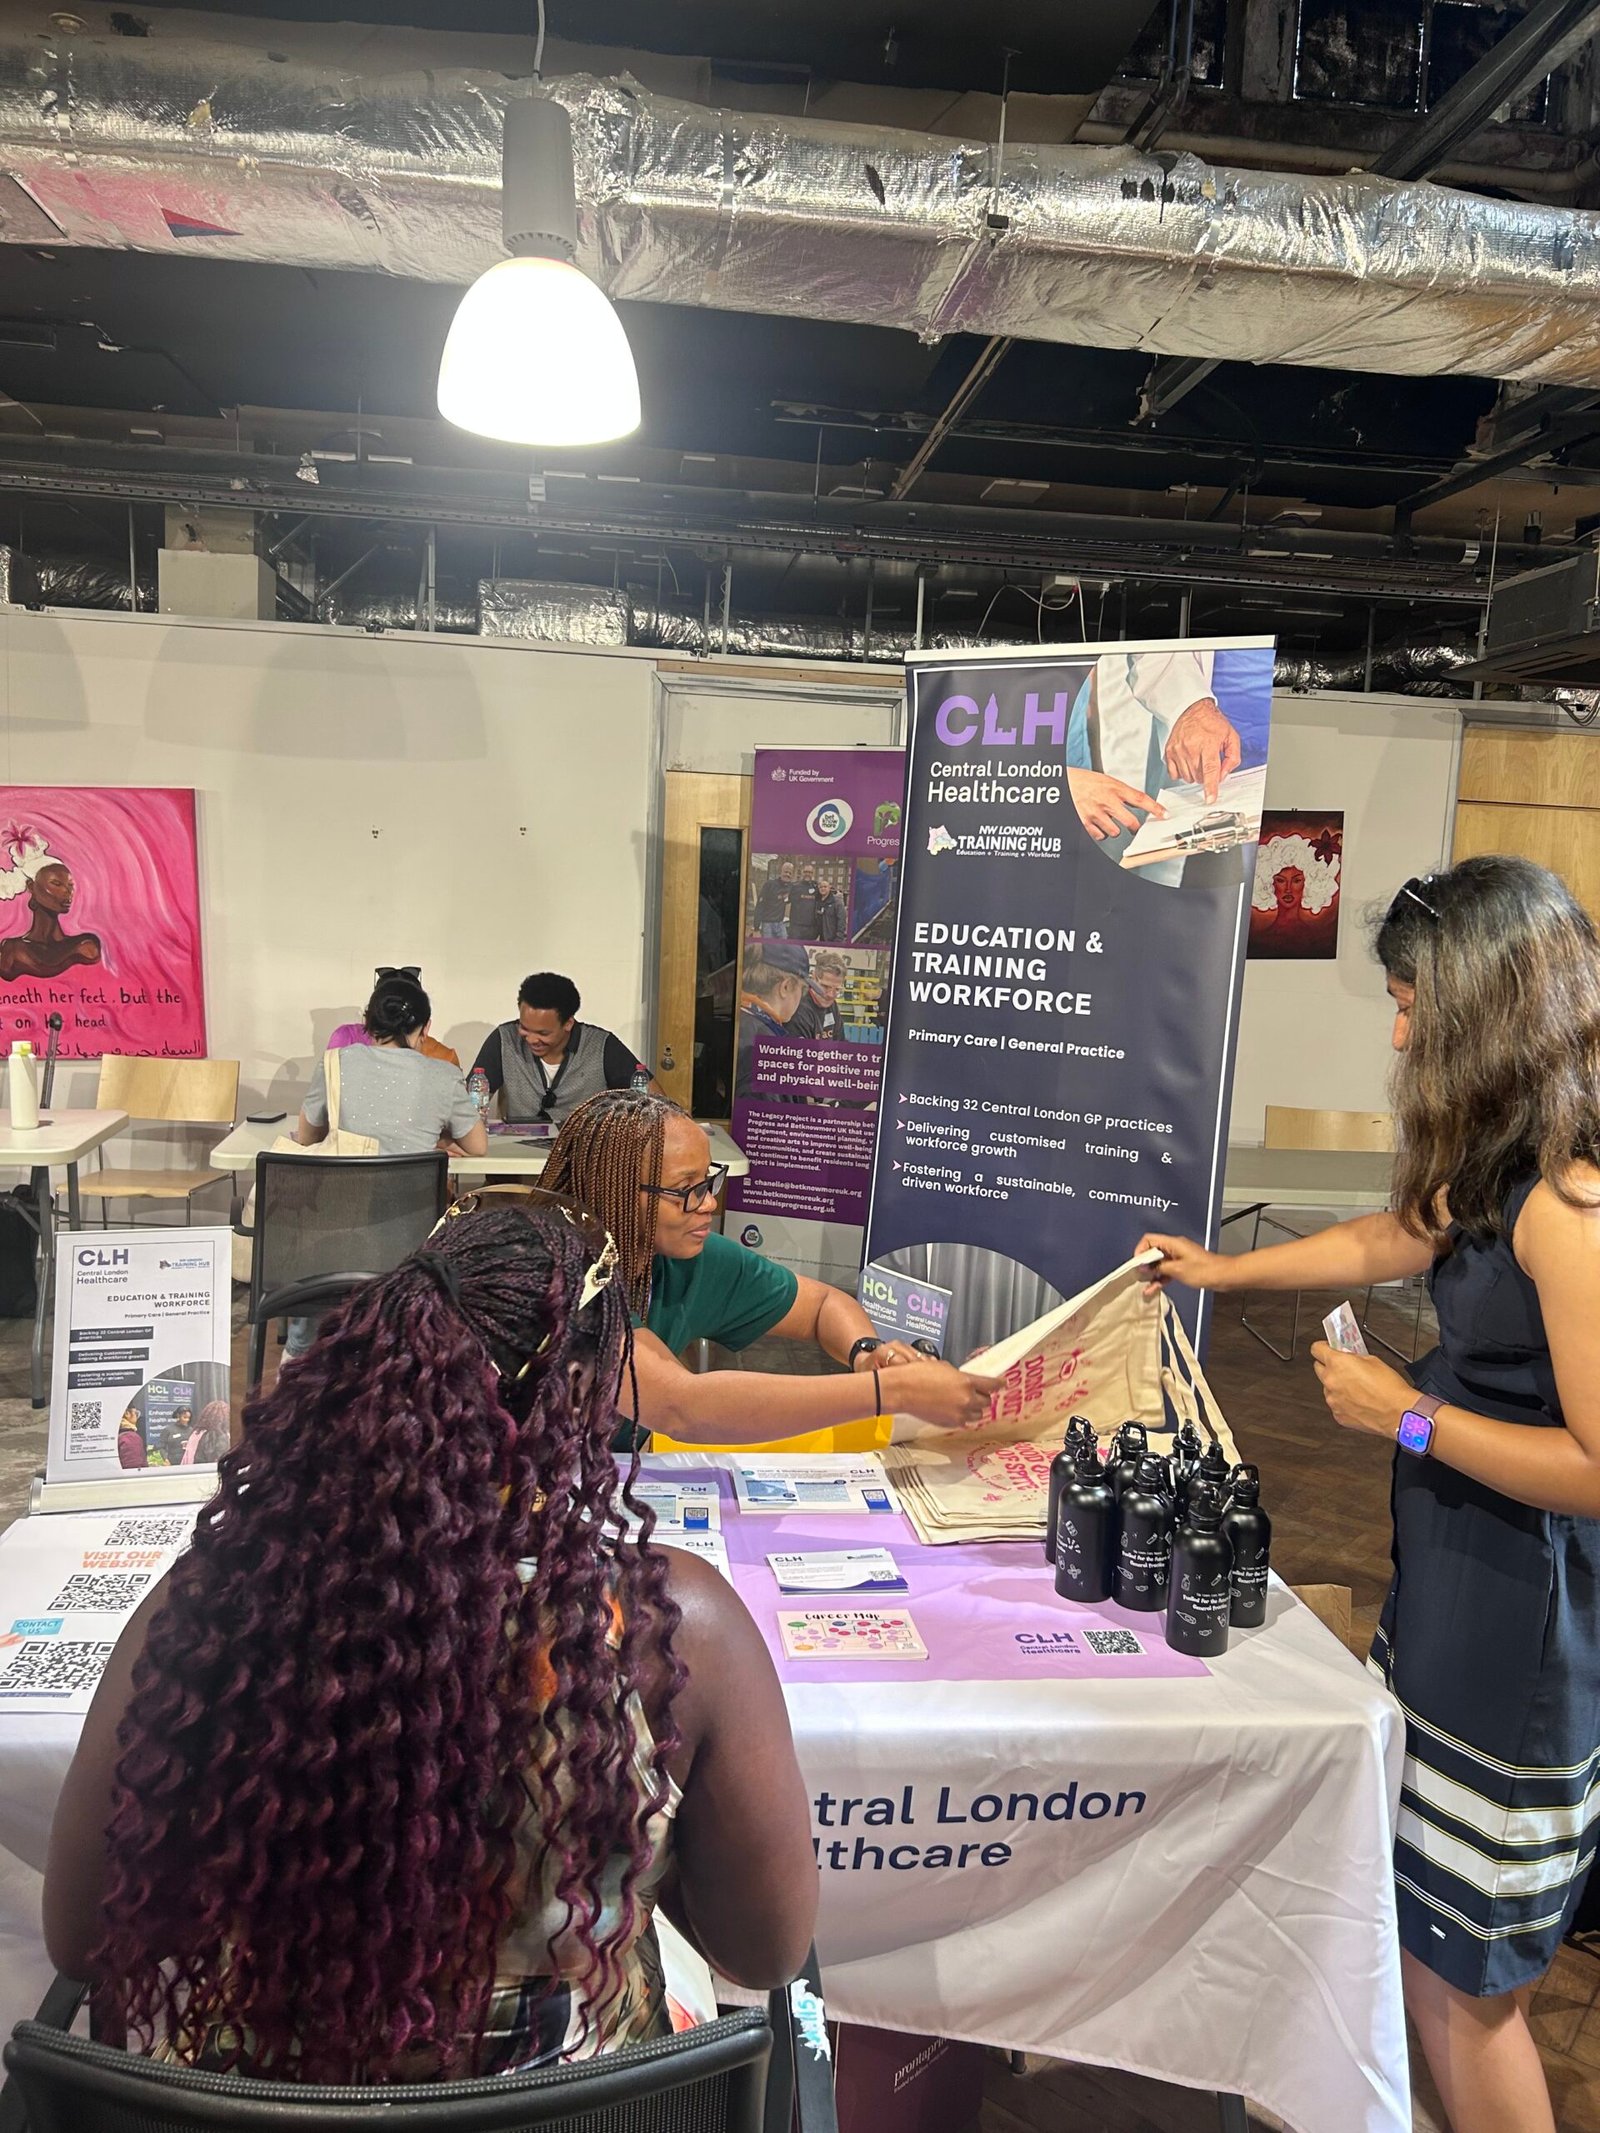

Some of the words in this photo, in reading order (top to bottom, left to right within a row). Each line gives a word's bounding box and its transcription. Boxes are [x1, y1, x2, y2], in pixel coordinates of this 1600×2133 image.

[935, 692, 1068, 746] CLH
[930, 761, 992, 778] Central
[998, 760, 1063, 778] London
[928, 780, 1061, 804] Healthcare
[979, 825, 998, 835] NW
[998, 826, 1043, 836] LONDON
[957, 835, 1027, 850] TRAINING
[1031, 838, 1061, 852] HUB
[914, 922, 1076, 952] EDUCATION
[1085, 931, 1104, 954] &
[911, 952, 1047, 982] TRAINING
[49, 988, 74, 1003] her
[120, 987, 148, 1004] but
[157, 989, 181, 1004] the
[909, 981, 1092, 1015] WORKFORCE
[15, 1018, 31, 1029] on
[75, 1014, 107, 1028] head
[759, 1044, 803, 1058] Working
[806, 1049, 853, 1062] together
[856, 1054, 868, 1063] to
[908, 1029, 961, 1048] Primary
[963, 1034, 998, 1049] Care
[1008, 1038, 1064, 1054] General
[1066, 1042, 1125, 1060] Practice
[757, 1059, 795, 1071] spaces
[798, 1061, 814, 1071] for
[817, 1063, 860, 1075] positive
[757, 1072, 776, 1082] and
[779, 1074, 825, 1086] physical
[909, 1093, 960, 1112] Backing
[962, 1098, 978, 1112] 32
[981, 1101, 1031, 1118] Central
[1033, 1106, 1081, 1123] London
[1083, 1113, 1102, 1125] GP
[1105, 1115, 1173, 1134] practices
[905, 1135, 968, 1154] workforce
[971, 1141, 1017, 1158] growth
[906, 1120, 970, 1140] Delivering
[989, 1130, 1066, 1150] customised
[1085, 1142, 1139, 1162] training
[1161, 1152, 1172, 1164] &
[902, 1176, 942, 1193] driven
[944, 1182, 1009, 1200] workforce
[903, 1161, 961, 1183] Fostering
[974, 1172, 983, 1182] a
[996, 1174, 1076, 1198] sustainable,
[1089, 1187, 1179, 1211] community-
[78, 1249, 129, 1266] CLH
[77, 1276, 128, 1284] Healthcare
[107, 1294, 157, 1302] EDUCATION
[863, 1275, 898, 1306] HCL
[154, 1300, 210, 1308] WORKFORCE
[862, 1298, 897, 1317] Healthcare
[907, 1293, 944, 1319] CLH
[905, 1319, 941, 1336] Healthcare
[148, 1385, 168, 1394] HCL
[82, 1560, 156, 1568] WEBSITE
[84, 1551, 125, 1560] VISIT
[126, 1551, 163, 1560] OUR
[1015, 1633, 1075, 1644] CLH
[936, 1781, 1146, 1824] London
